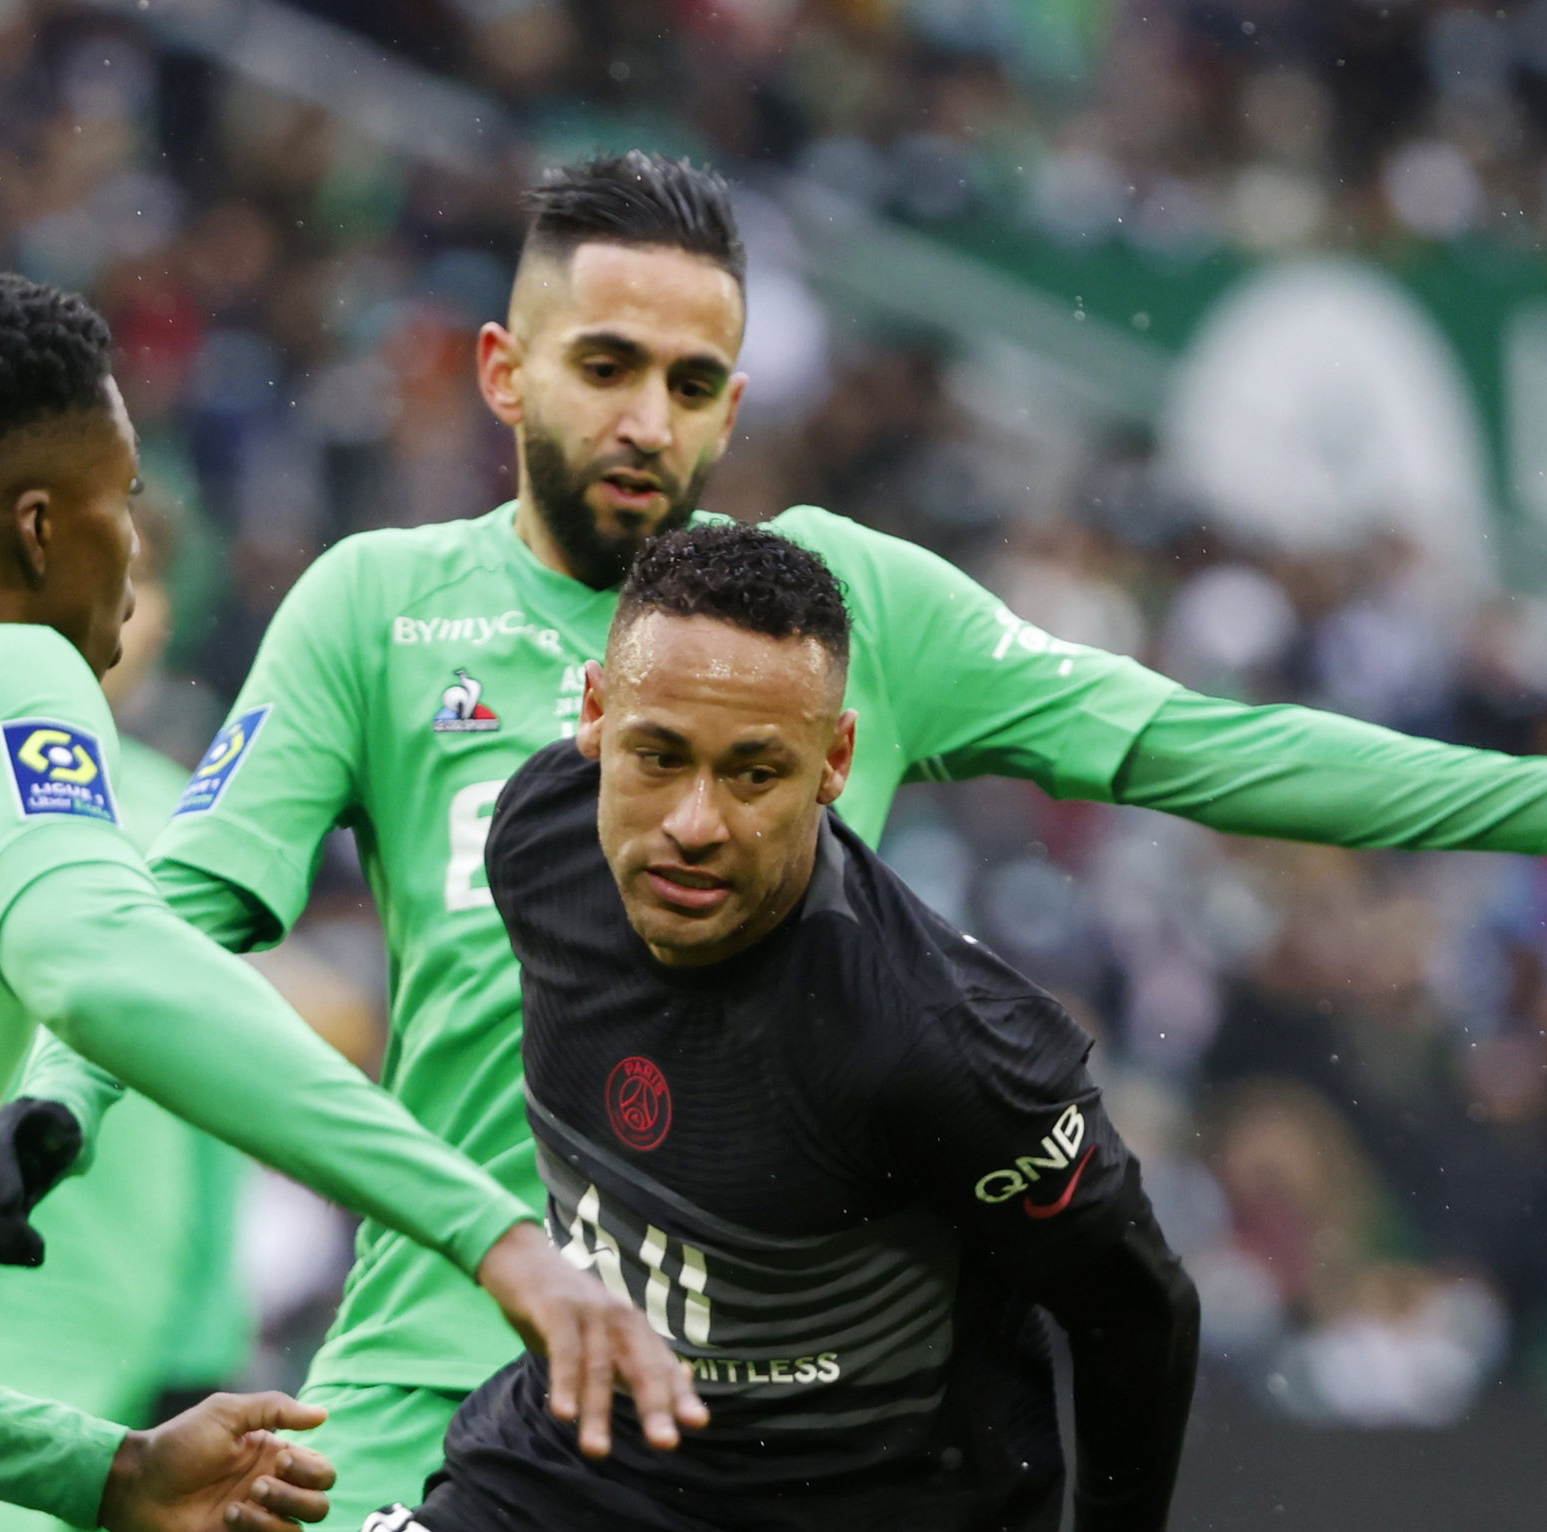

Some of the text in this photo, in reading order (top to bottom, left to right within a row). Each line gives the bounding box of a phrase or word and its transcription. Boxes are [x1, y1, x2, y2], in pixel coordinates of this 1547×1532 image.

[393, 610, 564, 655] BYmyCR
[974, 1103, 1085, 1203] QNB
[679, 1350, 841, 1384] MITLESS
